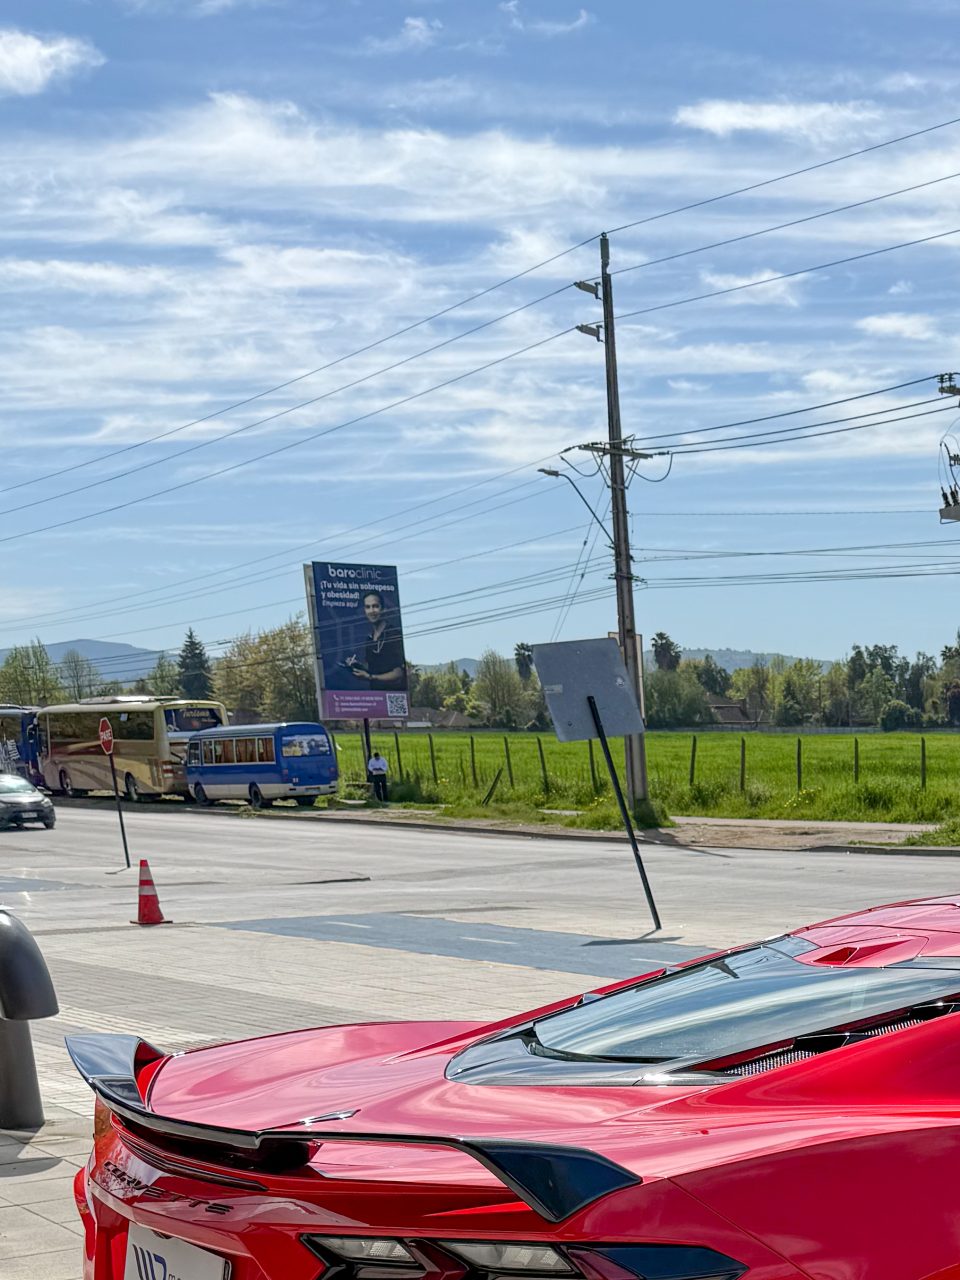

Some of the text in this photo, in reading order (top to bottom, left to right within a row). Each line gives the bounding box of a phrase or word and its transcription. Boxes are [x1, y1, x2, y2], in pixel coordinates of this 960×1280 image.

[328, 564, 382, 579] baroclinic
[333, 581, 347, 589] vida
[360, 582, 395, 592] sobrepeso
[100, 728, 112, 742] PARE
